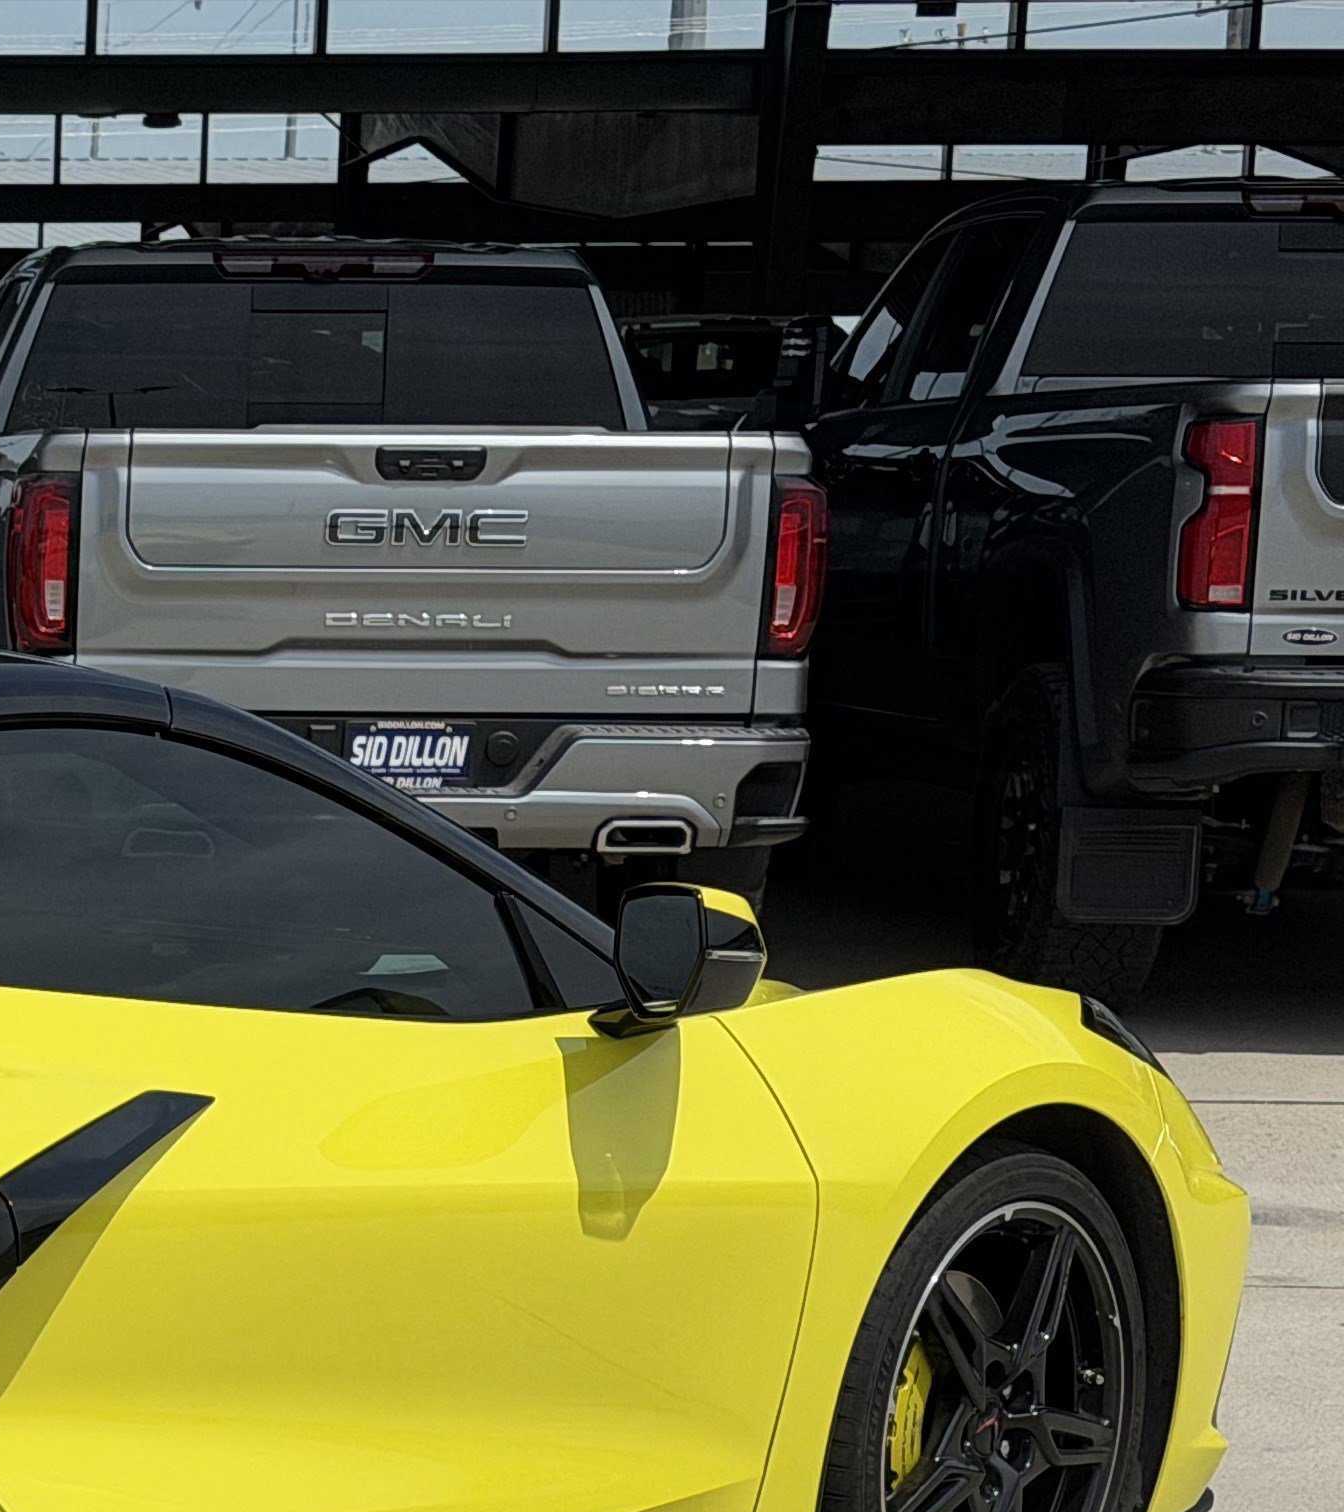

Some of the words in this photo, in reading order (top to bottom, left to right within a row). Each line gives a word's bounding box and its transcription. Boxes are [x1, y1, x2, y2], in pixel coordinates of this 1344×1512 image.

[325, 508, 529, 547] GMC
[325, 612, 512, 627] DENALI
[350, 735, 388, 767] SID
[389, 735, 470, 767] DILLON
